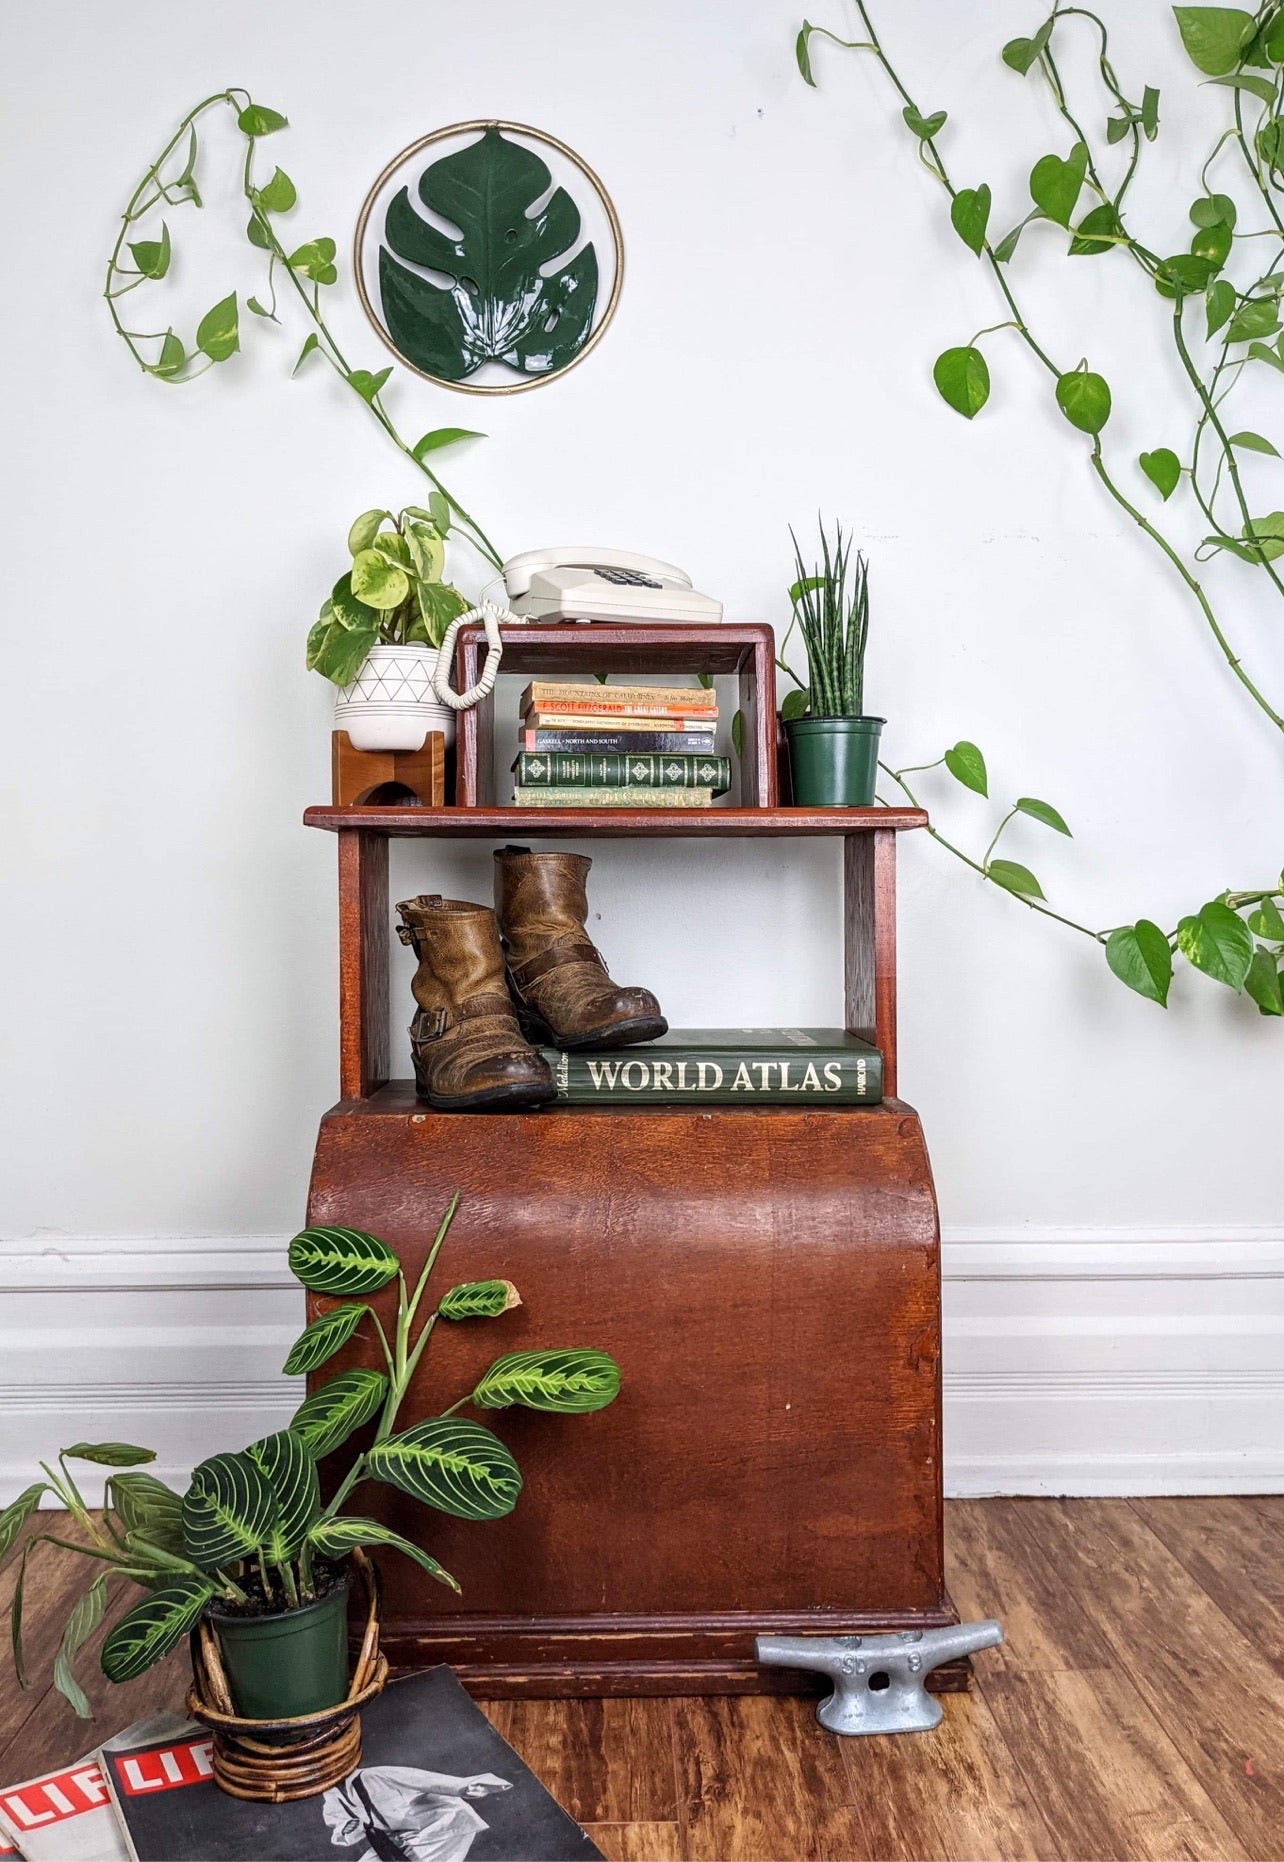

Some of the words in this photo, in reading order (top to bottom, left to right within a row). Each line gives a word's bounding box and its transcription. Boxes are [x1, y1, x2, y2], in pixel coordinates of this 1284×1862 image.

[551, 703, 575, 711] SCOTT
[577, 703, 623, 712] FITZGERALD
[556, 1052, 569, 1098] Medallion
[586, 1060, 723, 1092] WORLD
[731, 1061, 842, 1092] ATLAS
